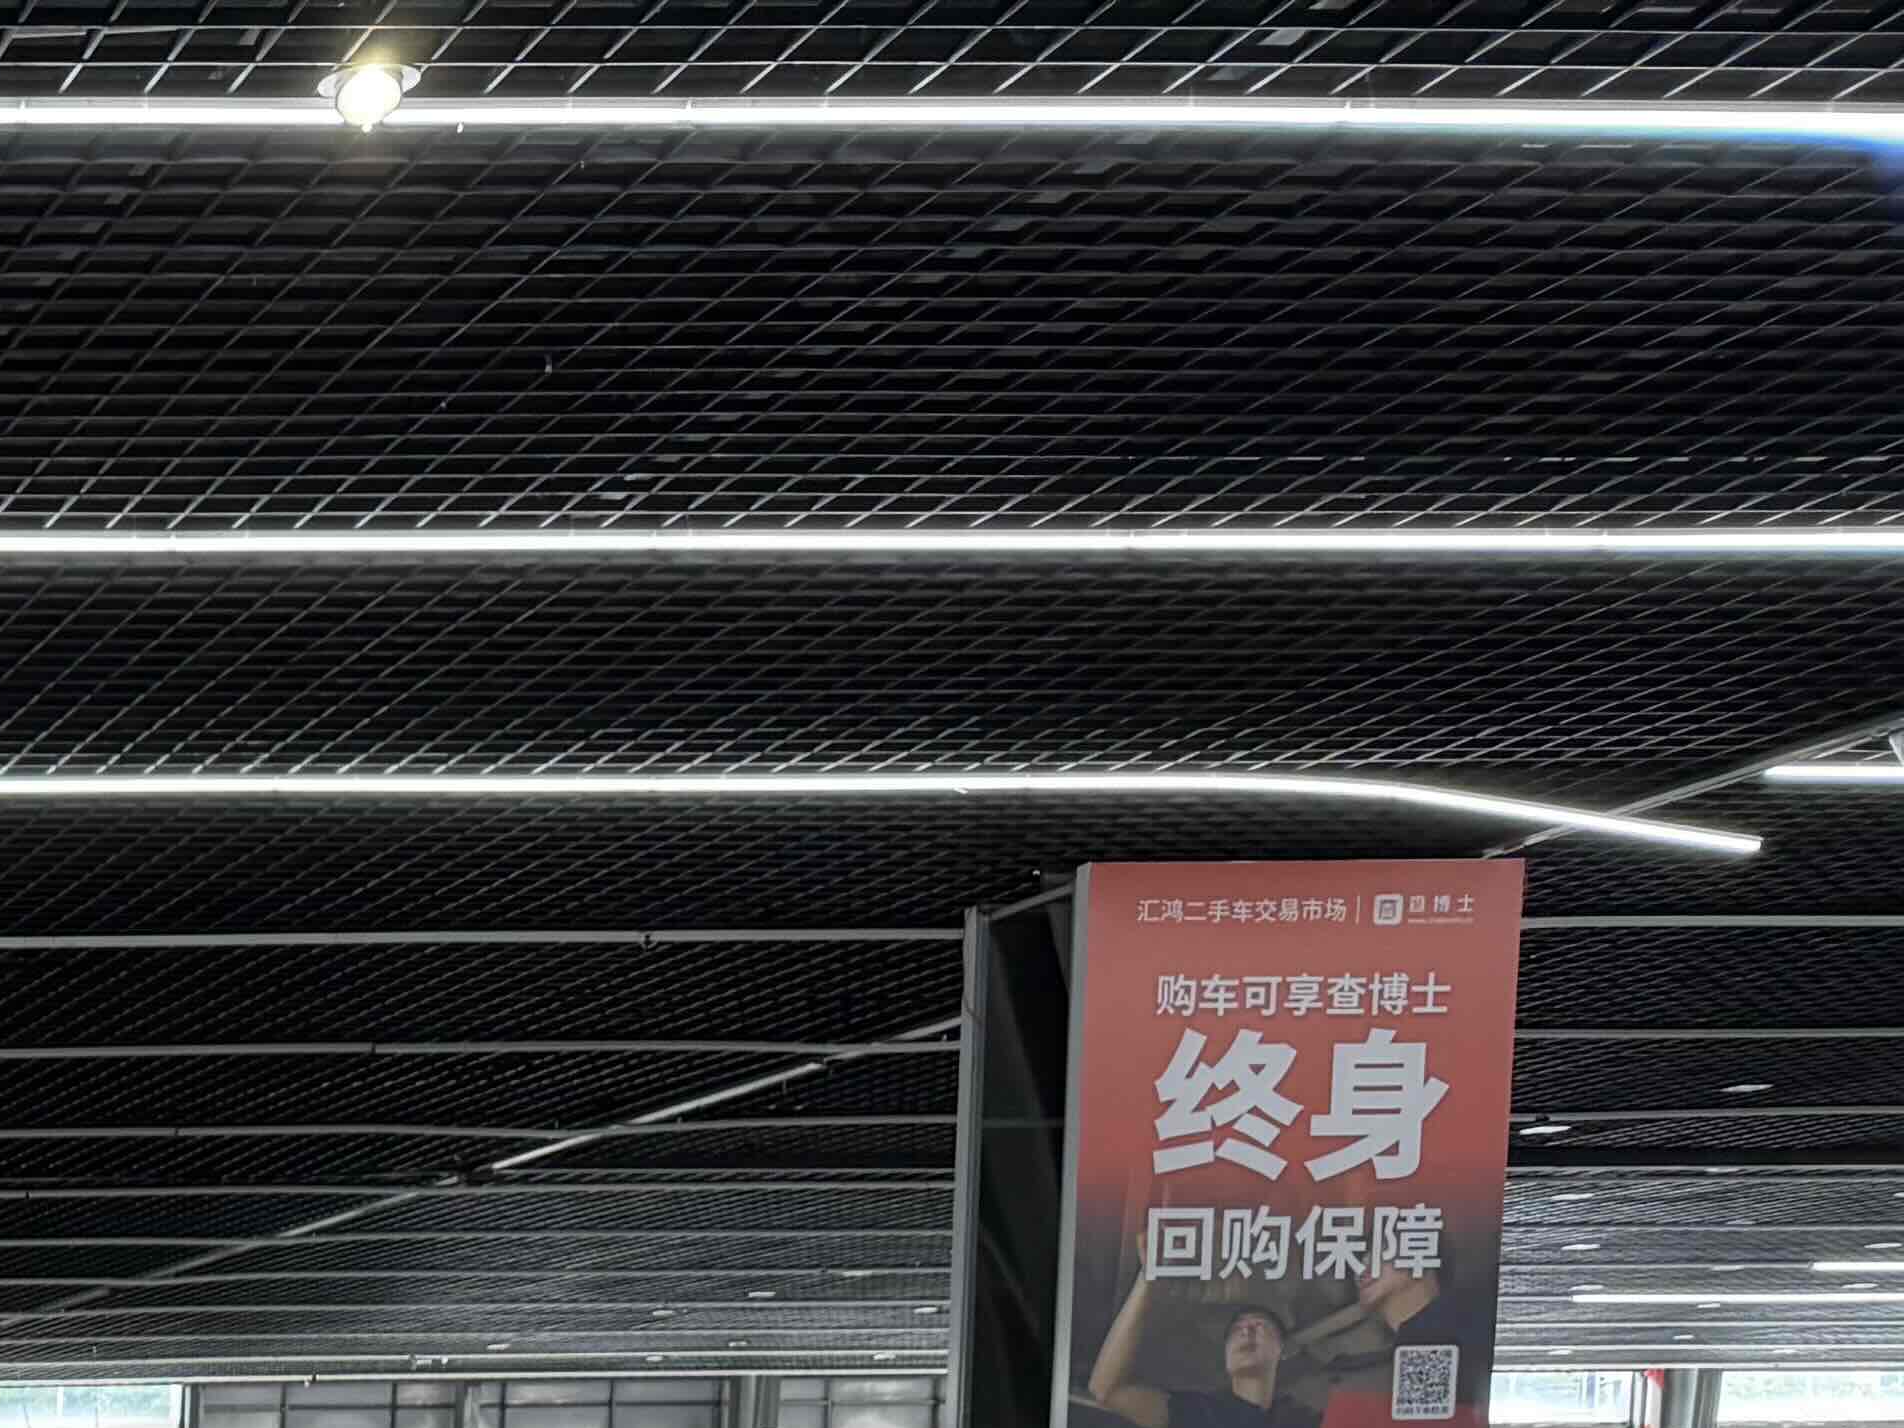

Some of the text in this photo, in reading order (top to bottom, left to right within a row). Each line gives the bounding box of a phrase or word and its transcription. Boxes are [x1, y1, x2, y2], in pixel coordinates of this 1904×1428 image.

[1136, 898, 1347, 923] 汇鸿二手车交易市场
[1155, 972, 1452, 1017] 购车可享查博士
[1151, 1027, 1450, 1182] 终身
[1143, 1204, 1445, 1282] 回购保障
